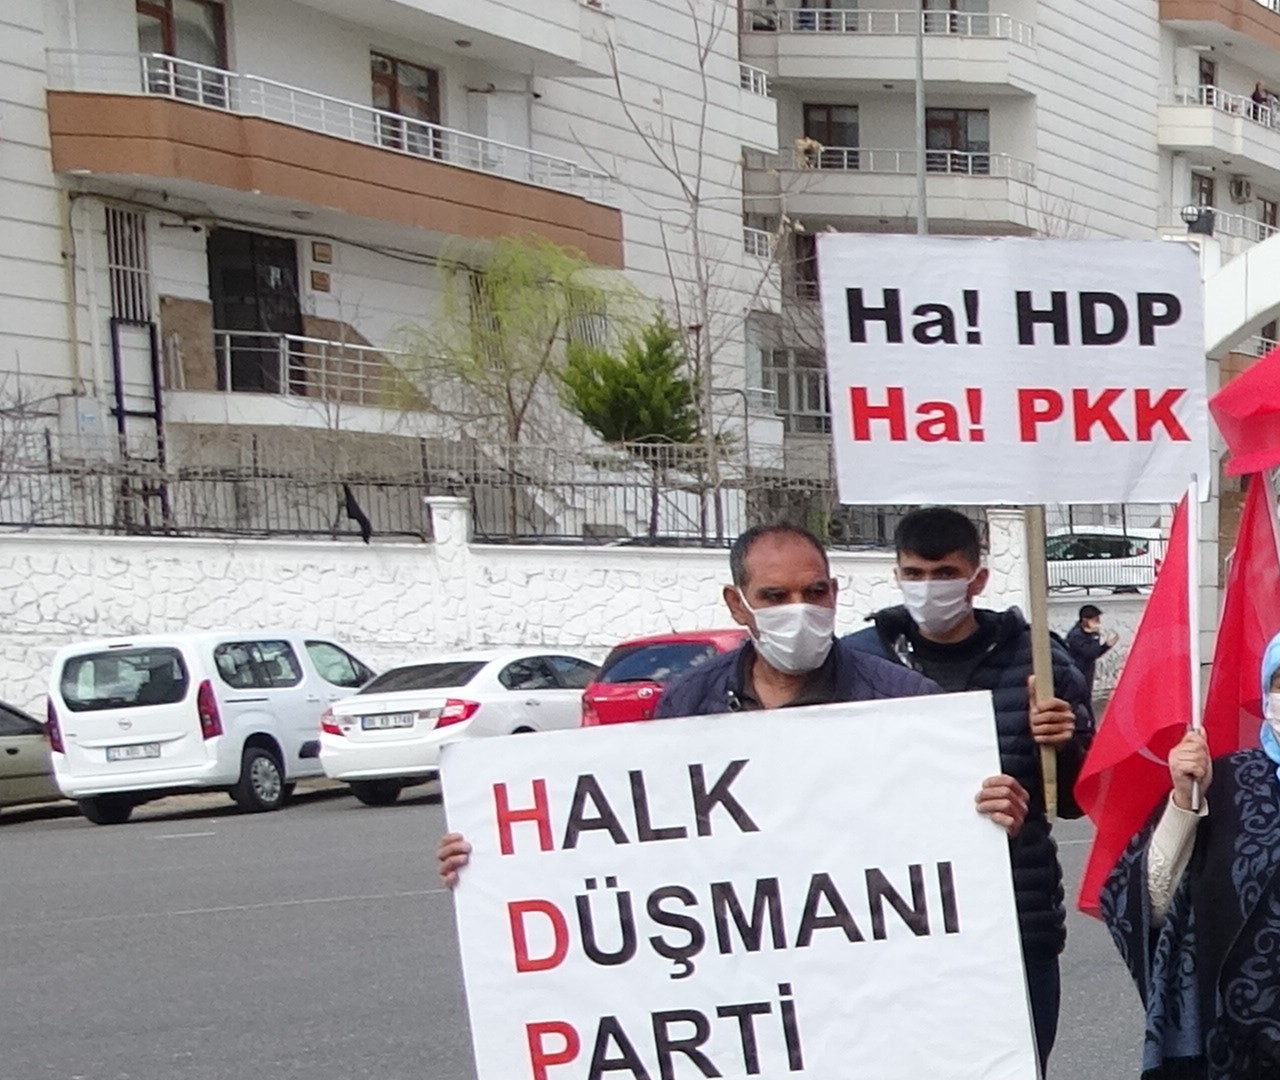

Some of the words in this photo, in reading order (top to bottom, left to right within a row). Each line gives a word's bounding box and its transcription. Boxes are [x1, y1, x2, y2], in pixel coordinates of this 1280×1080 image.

[845, 287, 982, 345] Ha!
[1014, 290, 1183, 346] HDP
[849, 386, 986, 443] Ha!
[1017, 388, 1192, 443] PKK
[493, 758, 760, 856] HALK
[507, 860, 961, 980] DÜŞMANI
